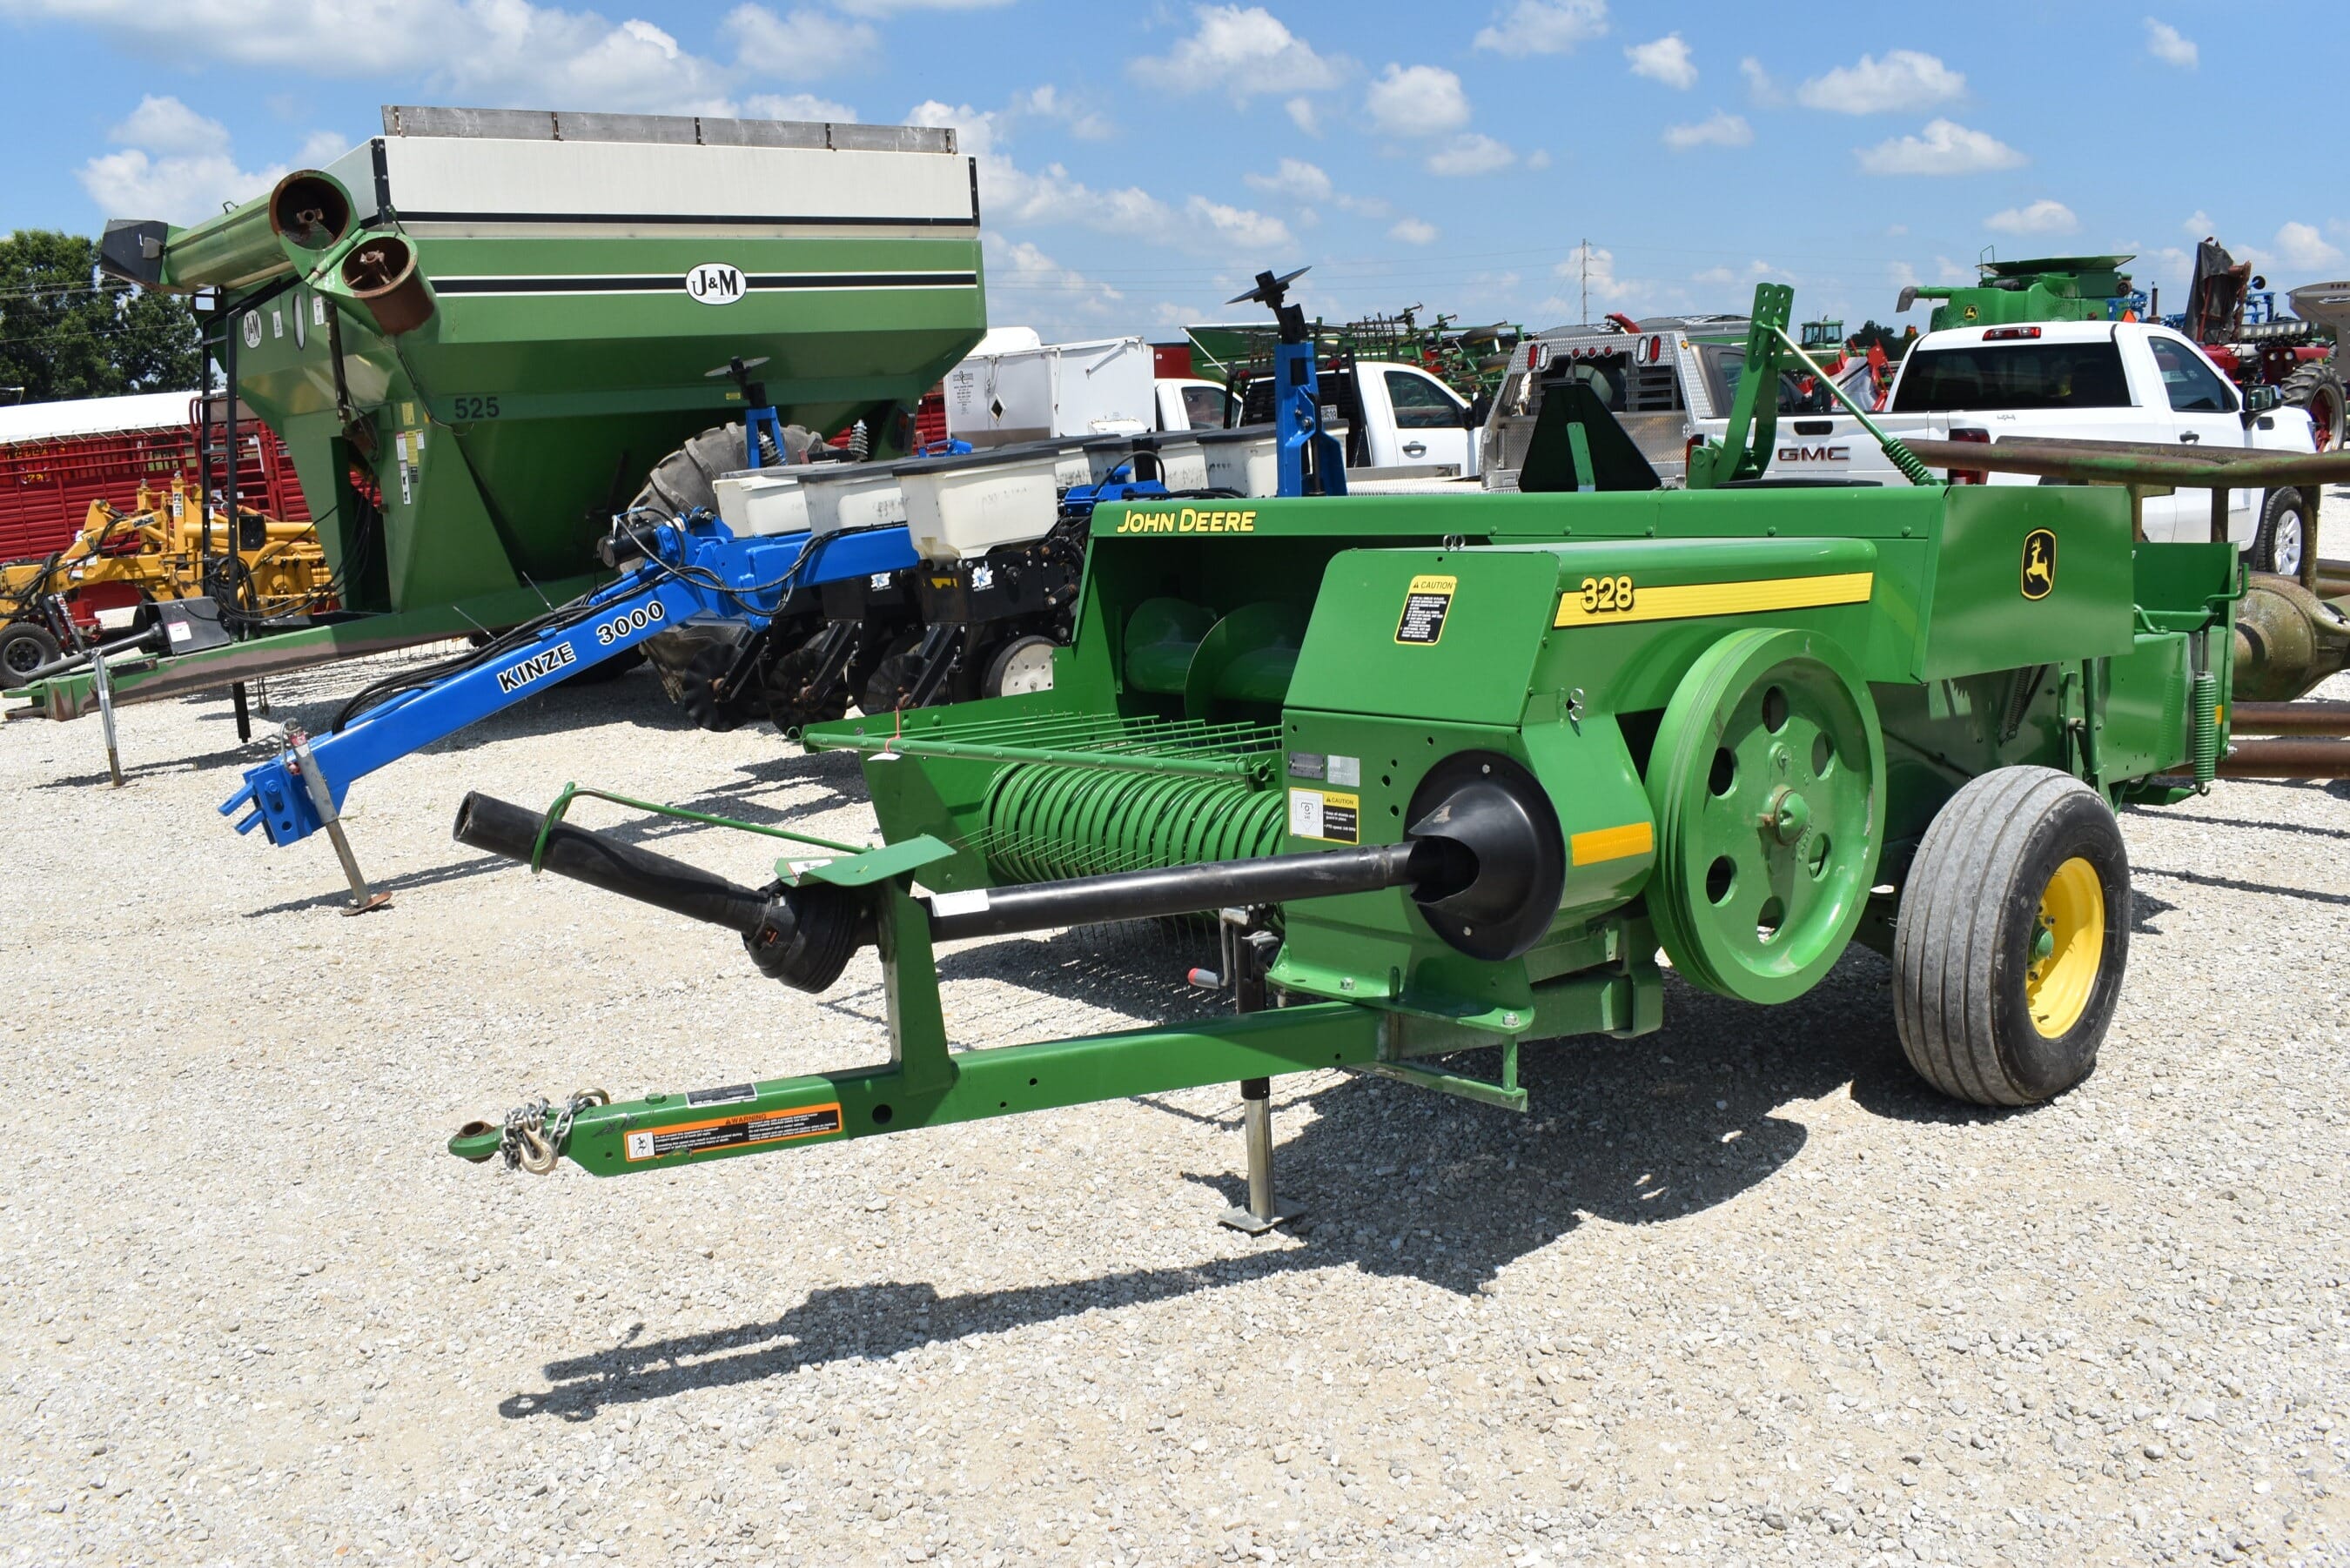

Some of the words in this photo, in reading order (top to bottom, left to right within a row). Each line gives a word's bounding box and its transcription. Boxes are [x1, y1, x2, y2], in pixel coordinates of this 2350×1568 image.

[690, 269, 739, 297] J&M
[245, 314, 260, 341] J&M
[454, 397, 500, 419] 525
[1777, 446, 1851, 461] GMC
[1116, 509, 1176, 533] JOHN
[1178, 507, 1257, 533] DEERE
[1420, 580, 1454, 589] CAUTION
[1580, 575, 1635, 613] 328
[496, 641, 577, 694] KINZE
[596, 600, 665, 646] 3000
[1332, 797, 1354, 806] CAUTION
[731, 1113, 767, 1123] WARNING
